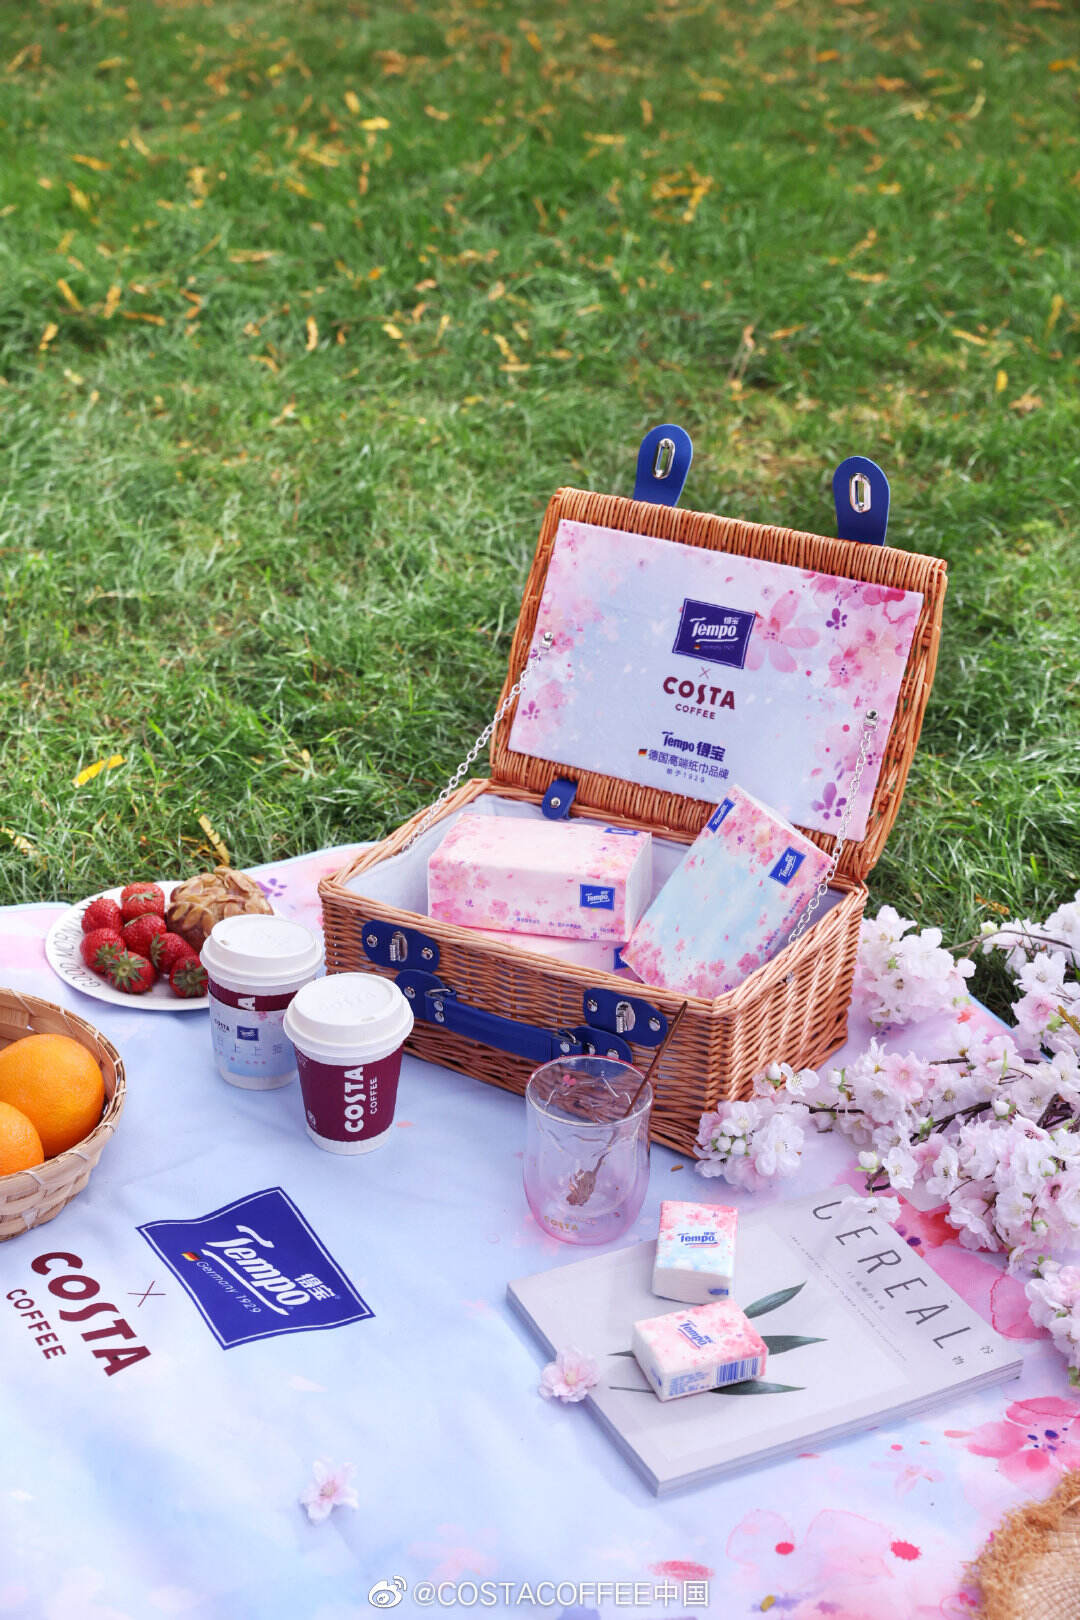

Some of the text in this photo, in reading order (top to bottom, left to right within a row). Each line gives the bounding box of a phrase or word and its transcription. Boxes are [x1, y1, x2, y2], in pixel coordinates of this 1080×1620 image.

[689, 617, 738, 638] Tempo
[662, 676, 735, 710] COSTA
[675, 703, 716, 720] COFFEE
[662, 731, 726, 762] Tempo 得宝
[343, 1066, 367, 1133] COSTA
[369, 1076, 378, 1115] COFFEE
[677, 1232, 716, 1244] Tempo
[205, 1224, 311, 1306] Tempo
[812, 1200, 972, 1350] CEREAL
[196, 1261, 261, 1313] Germany 1929
[6, 1288, 67, 1360] COFFEE
[30, 1251, 152, 1377] COSTA
[679, 1319, 709, 1347] Tempo
